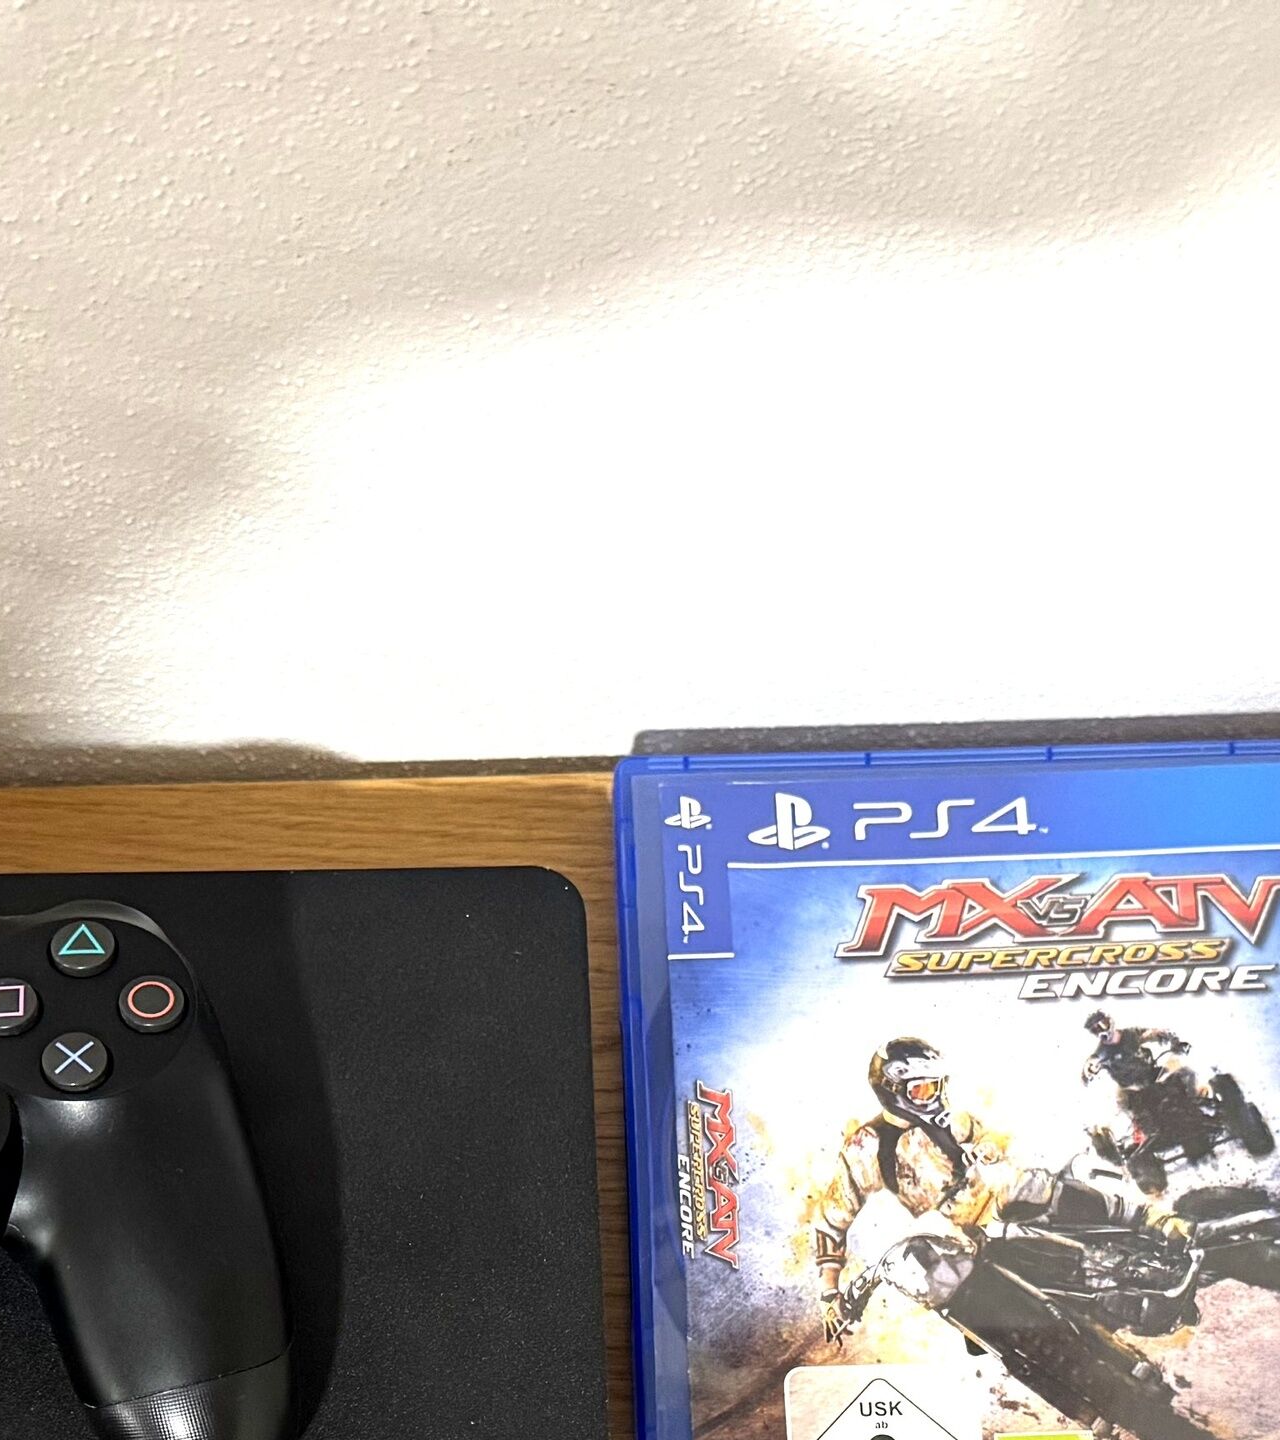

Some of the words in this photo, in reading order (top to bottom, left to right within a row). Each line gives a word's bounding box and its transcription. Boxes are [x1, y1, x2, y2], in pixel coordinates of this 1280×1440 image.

[853, 796, 1037, 841] PS4
[677, 844, 706, 935] PS4
[887, 938, 1229, 977] SUPERCROSS
[1018, 963, 1278, 1000] ENCORE
[688, 1100, 708, 1242] SUPERCROSS
[677, 1154, 695, 1260] ENCORE
[859, 1400, 904, 1417] USK
[874, 1420, 889, 1430] ab
